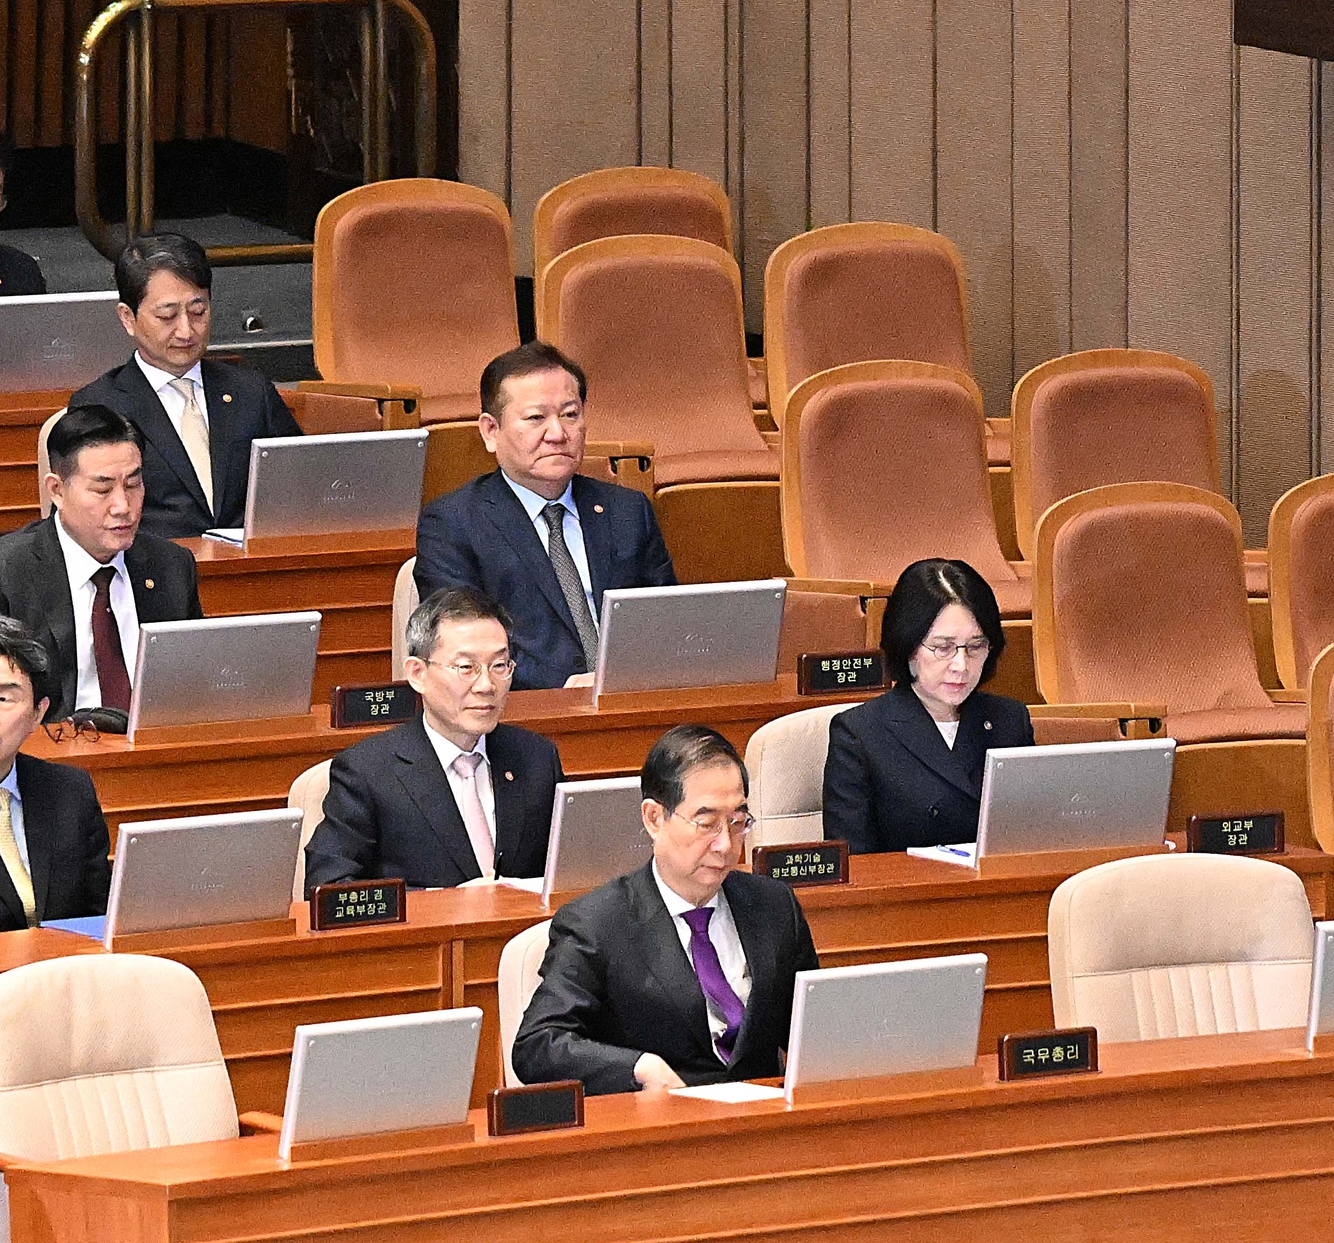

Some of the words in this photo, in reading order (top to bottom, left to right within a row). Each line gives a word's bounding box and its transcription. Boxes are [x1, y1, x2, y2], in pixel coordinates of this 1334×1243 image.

[821, 657, 873, 672] 행정안전부
[836, 671, 857, 684] 장관
[364, 690, 395, 703] 국방부
[370, 703, 390, 716] 장관
[1221, 819, 1254, 833] 외교부
[1227, 833, 1248, 846] 장관
[785, 852, 822, 866] 과학기술
[772, 862, 835, 879] 정보통신부장관
[338, 889, 370, 905] 부총리
[335, 901, 387, 918] 교육부장관
[1022, 1043, 1079, 1065] 국무총리
